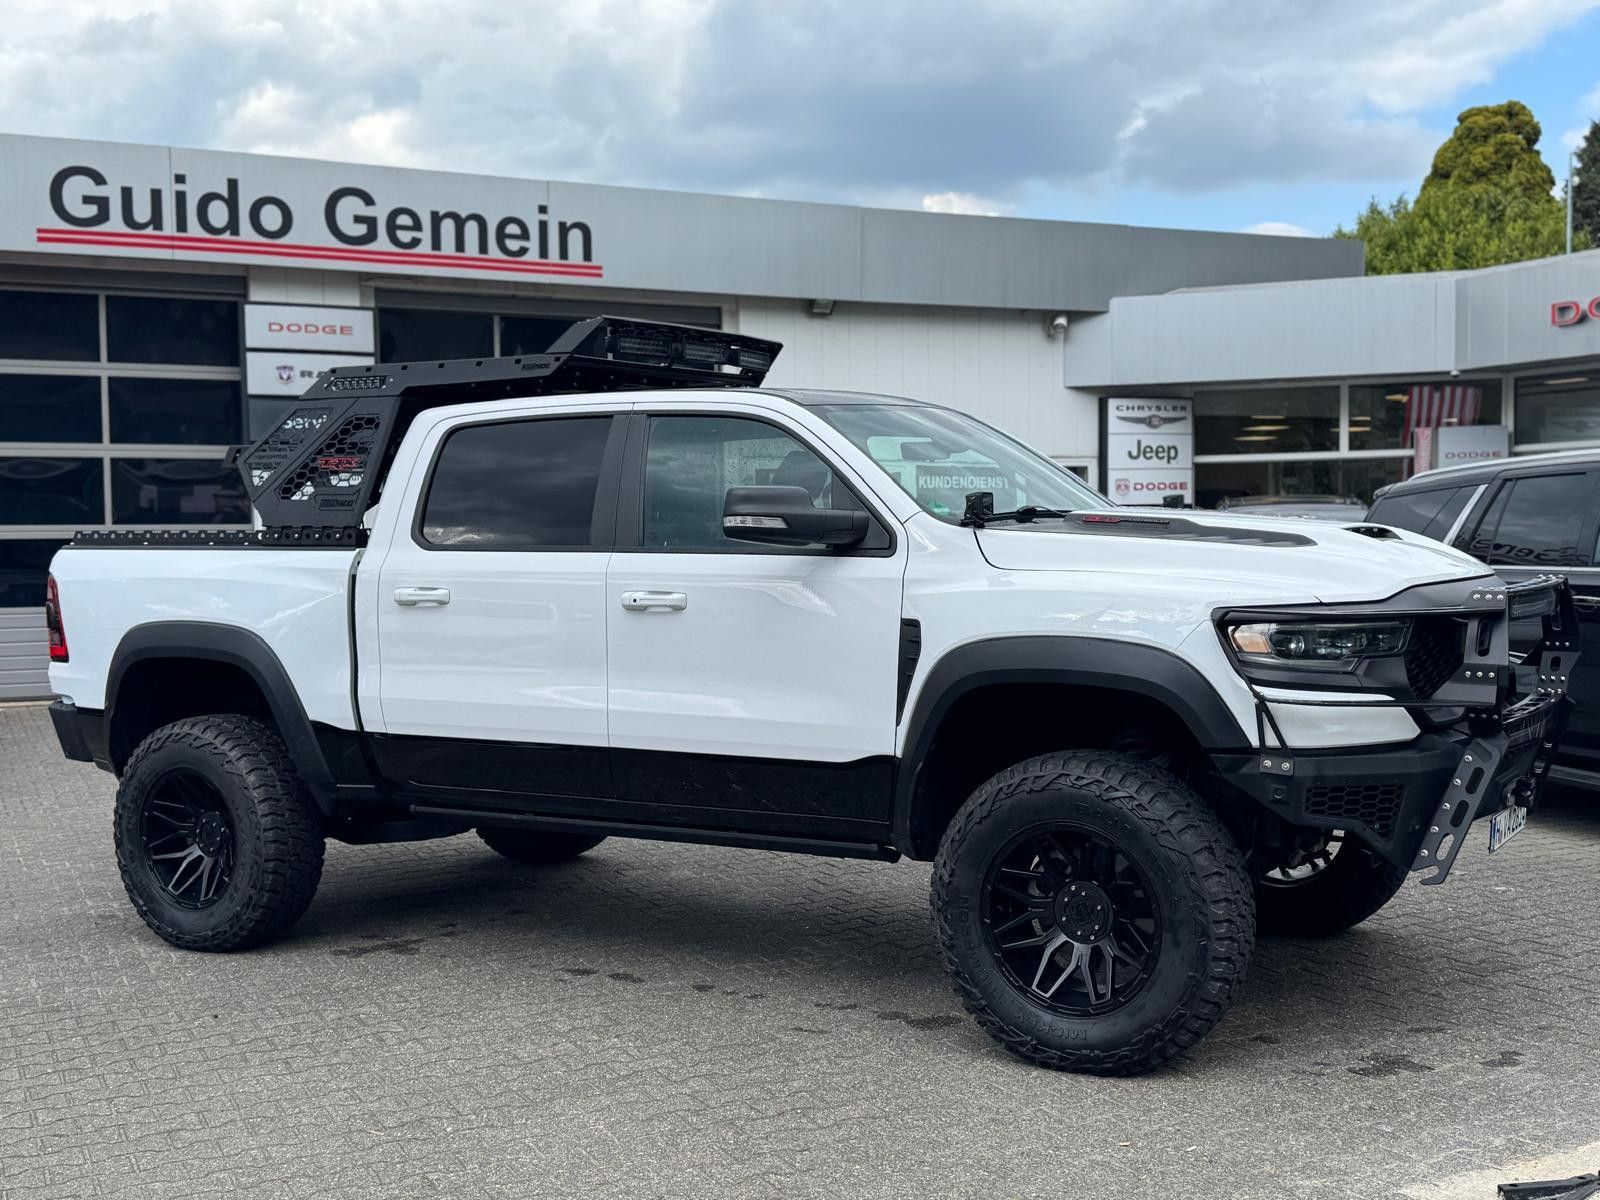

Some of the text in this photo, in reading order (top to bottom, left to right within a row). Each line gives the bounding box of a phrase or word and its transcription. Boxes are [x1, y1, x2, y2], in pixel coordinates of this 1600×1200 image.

[49, 165, 593, 262] Guido Gemein
[268, 322, 353, 335] DODGE
[1128, 439, 1178, 464] Jeep
[1444, 451, 1500, 459] DODGE
[1133, 482, 1187, 491] DODGE
